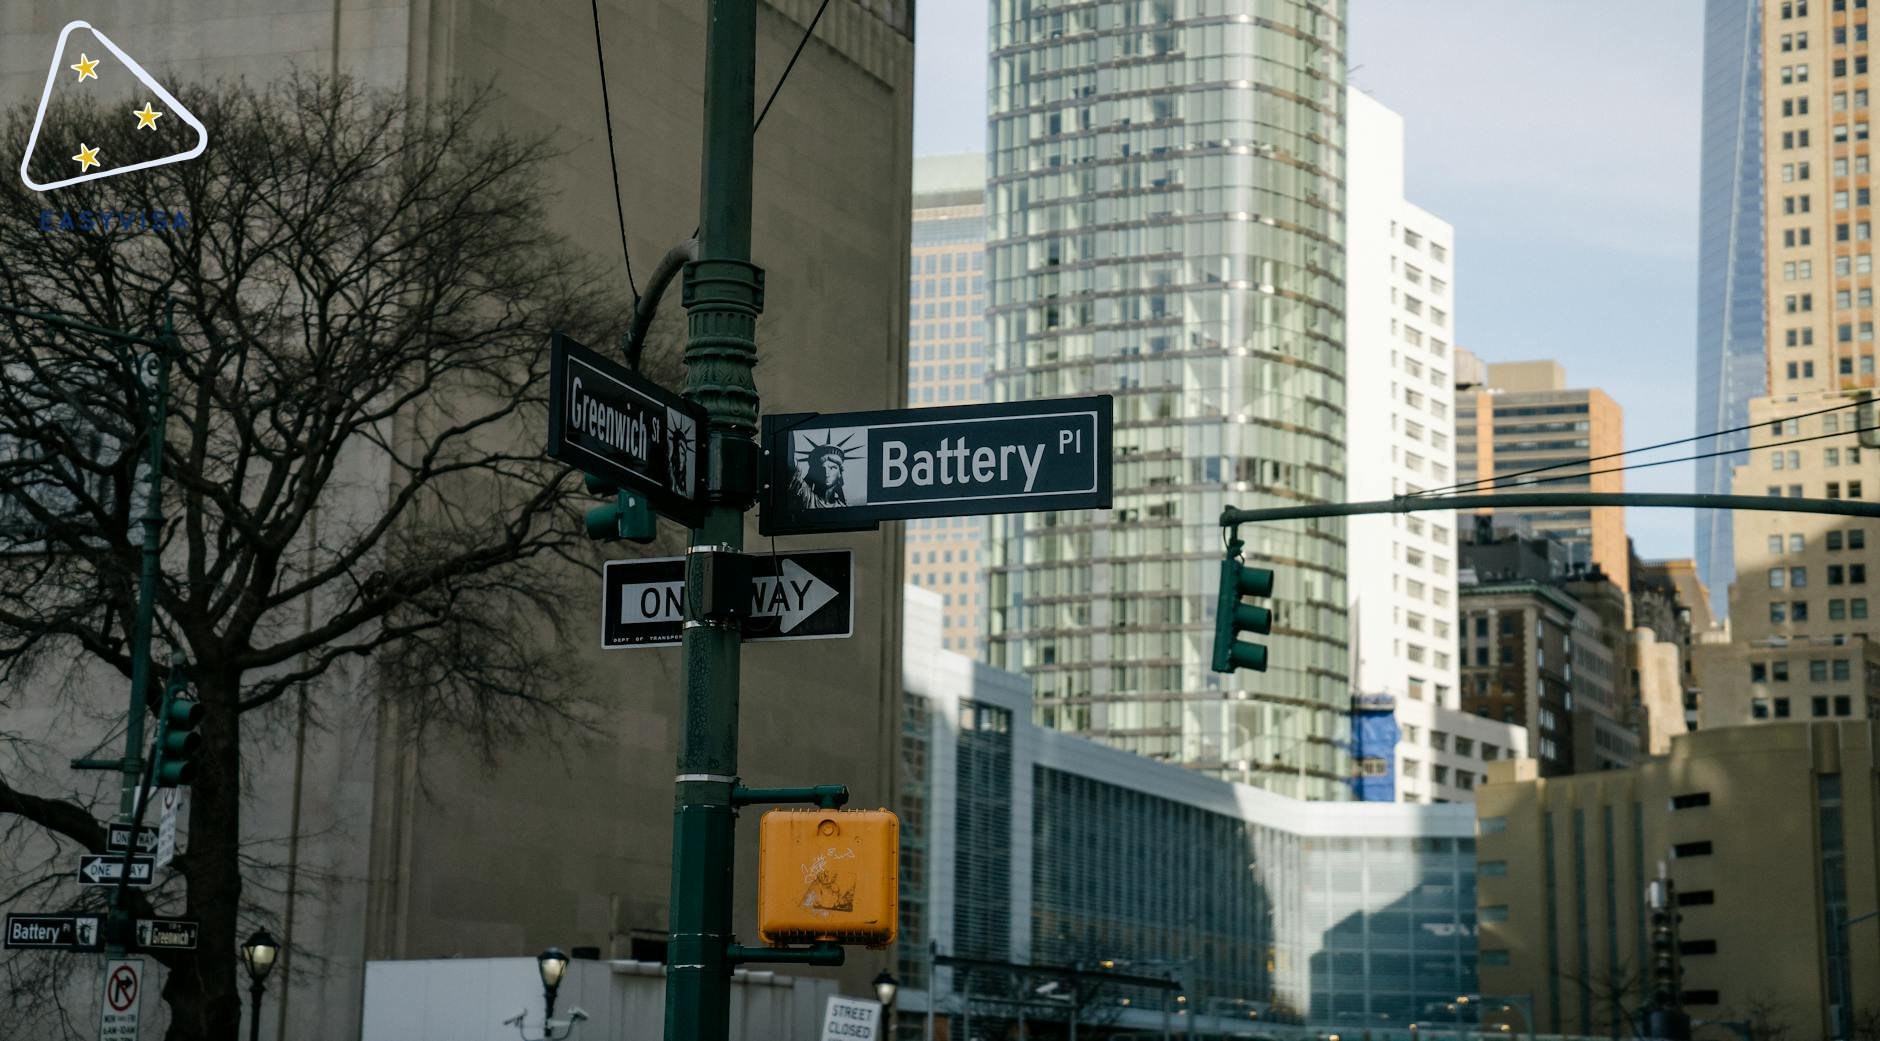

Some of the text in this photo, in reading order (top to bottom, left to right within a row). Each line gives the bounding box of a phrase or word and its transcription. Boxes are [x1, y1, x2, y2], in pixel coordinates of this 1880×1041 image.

[571, 376, 647, 461] Greenwich
[882, 429, 1081, 493] Battery Pl
[640, 587, 684, 618] ON
[116, 832, 129, 843] ON
[90, 864, 144, 876] ONE AY
[12, 922, 60, 944] Battery
[153, 927, 189, 945] Greenwich
[832, 1004, 872, 1021] STREET
[828, 1020, 870, 1038] CLOSED
